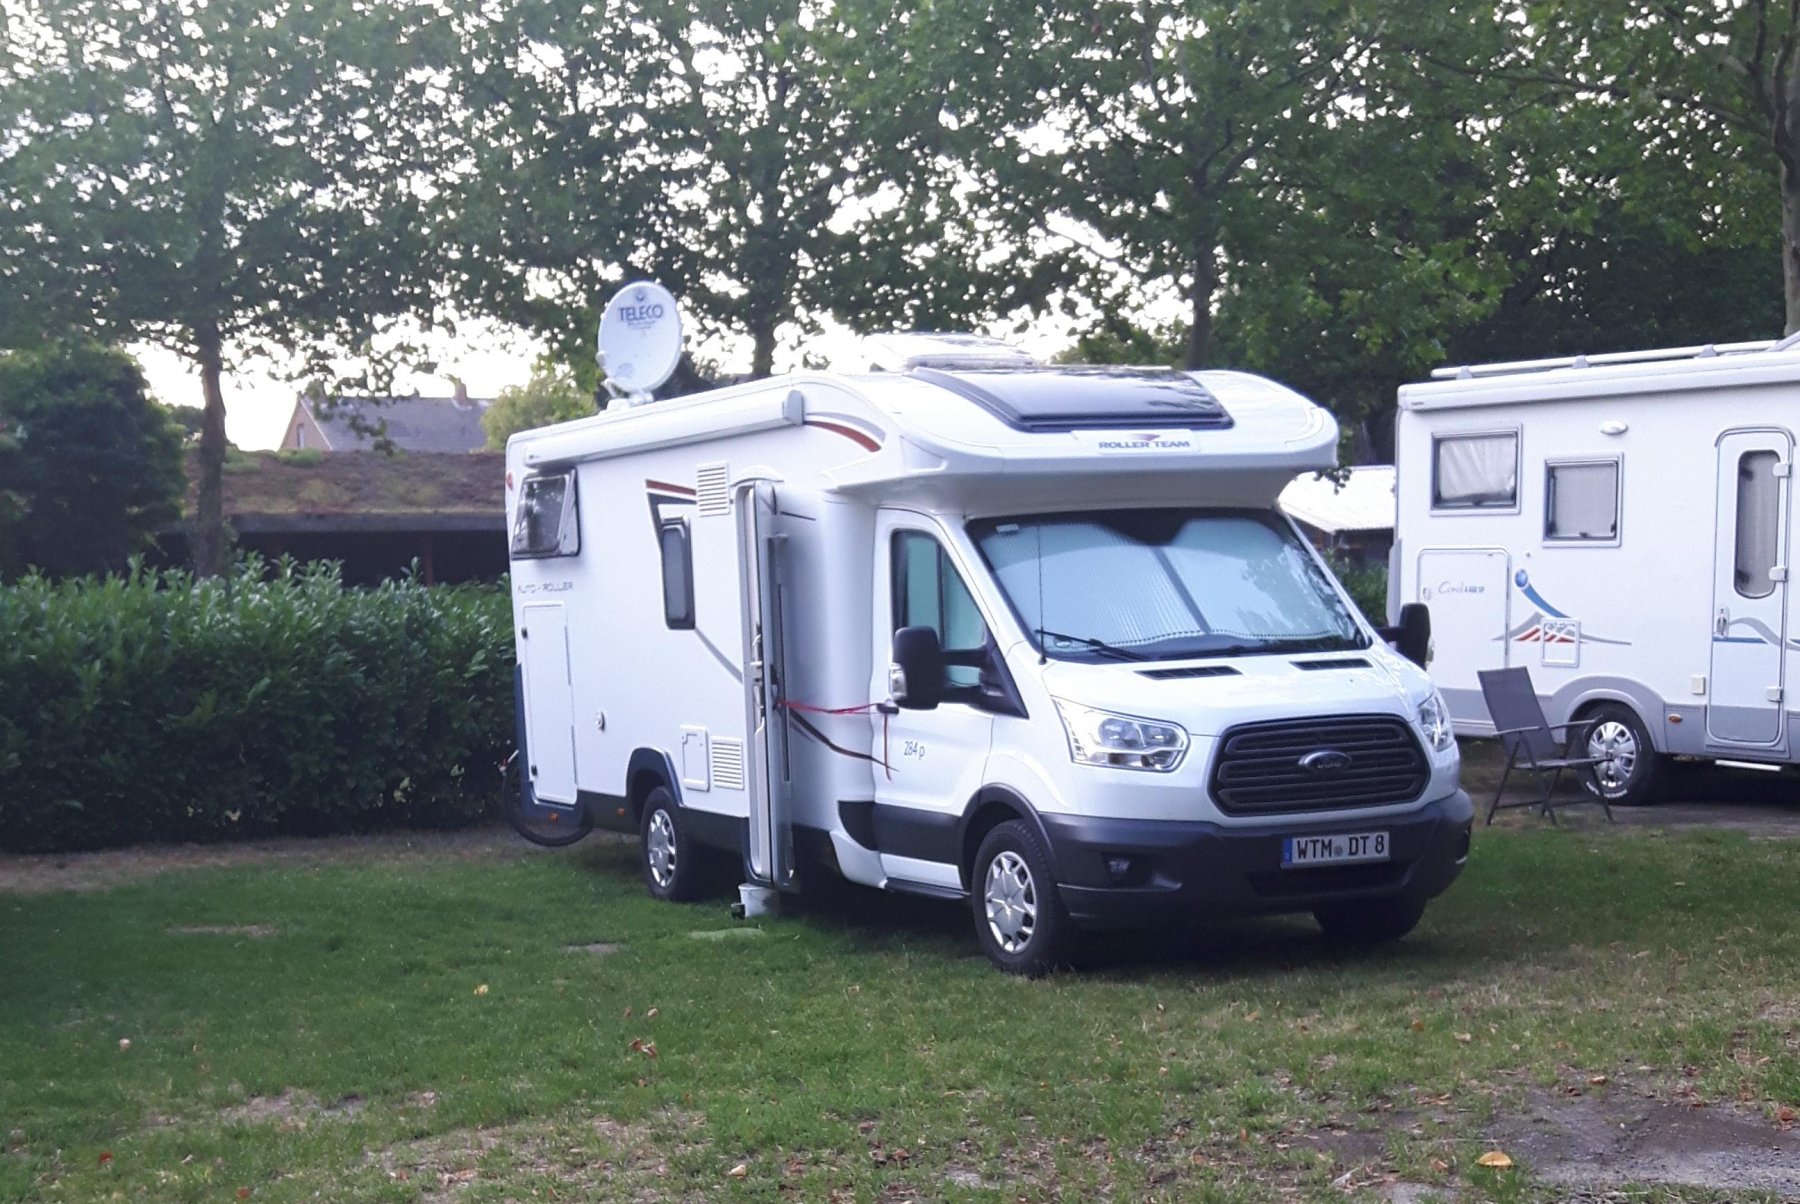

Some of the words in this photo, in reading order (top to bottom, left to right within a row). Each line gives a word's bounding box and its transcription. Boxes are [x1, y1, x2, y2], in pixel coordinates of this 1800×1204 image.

[618, 304, 664, 321] TELECO
[1099, 441, 1150, 449] ROLLER
[1153, 440, 1190, 448] TEAM
[1297, 839, 1333, 859] WTM
[1349, 836, 1370, 856] DT
[1375, 834, 1385, 854] 8
